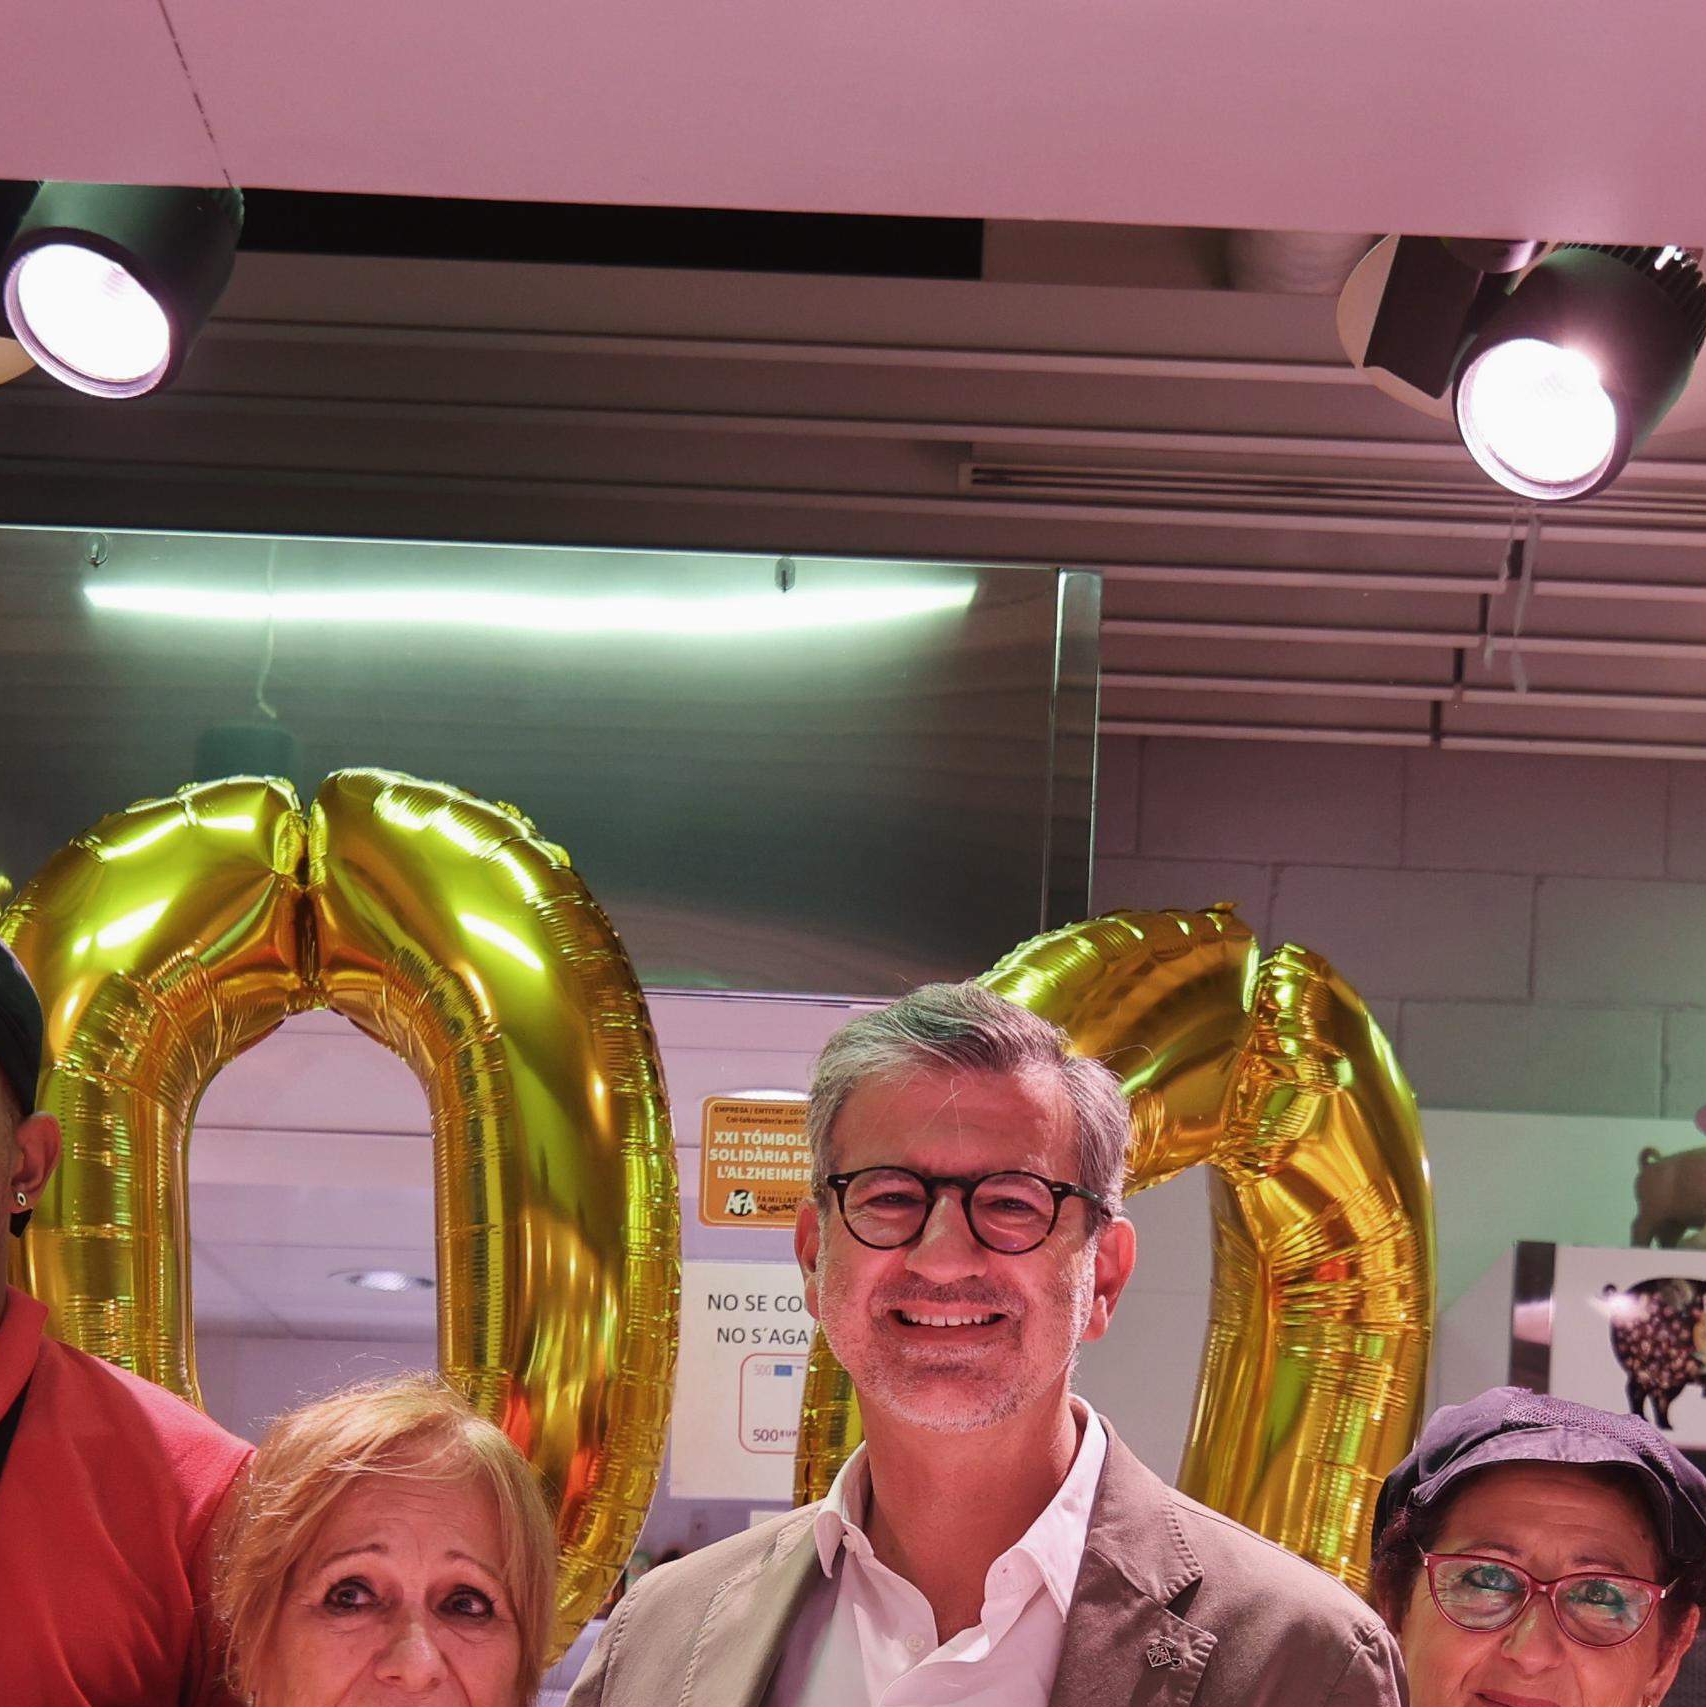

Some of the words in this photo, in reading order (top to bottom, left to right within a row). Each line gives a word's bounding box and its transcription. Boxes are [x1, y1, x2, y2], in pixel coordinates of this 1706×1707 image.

[714, 1131, 739, 1144] XXI
[709, 1147, 790, 1163] SOLIDÀRIA
[792, 1151, 813, 1164] PE
[707, 1293, 738, 1311] NO
[745, 1294, 767, 1312] SE
[774, 1295, 804, 1312] CO
[717, 1327, 745, 1343] NO
